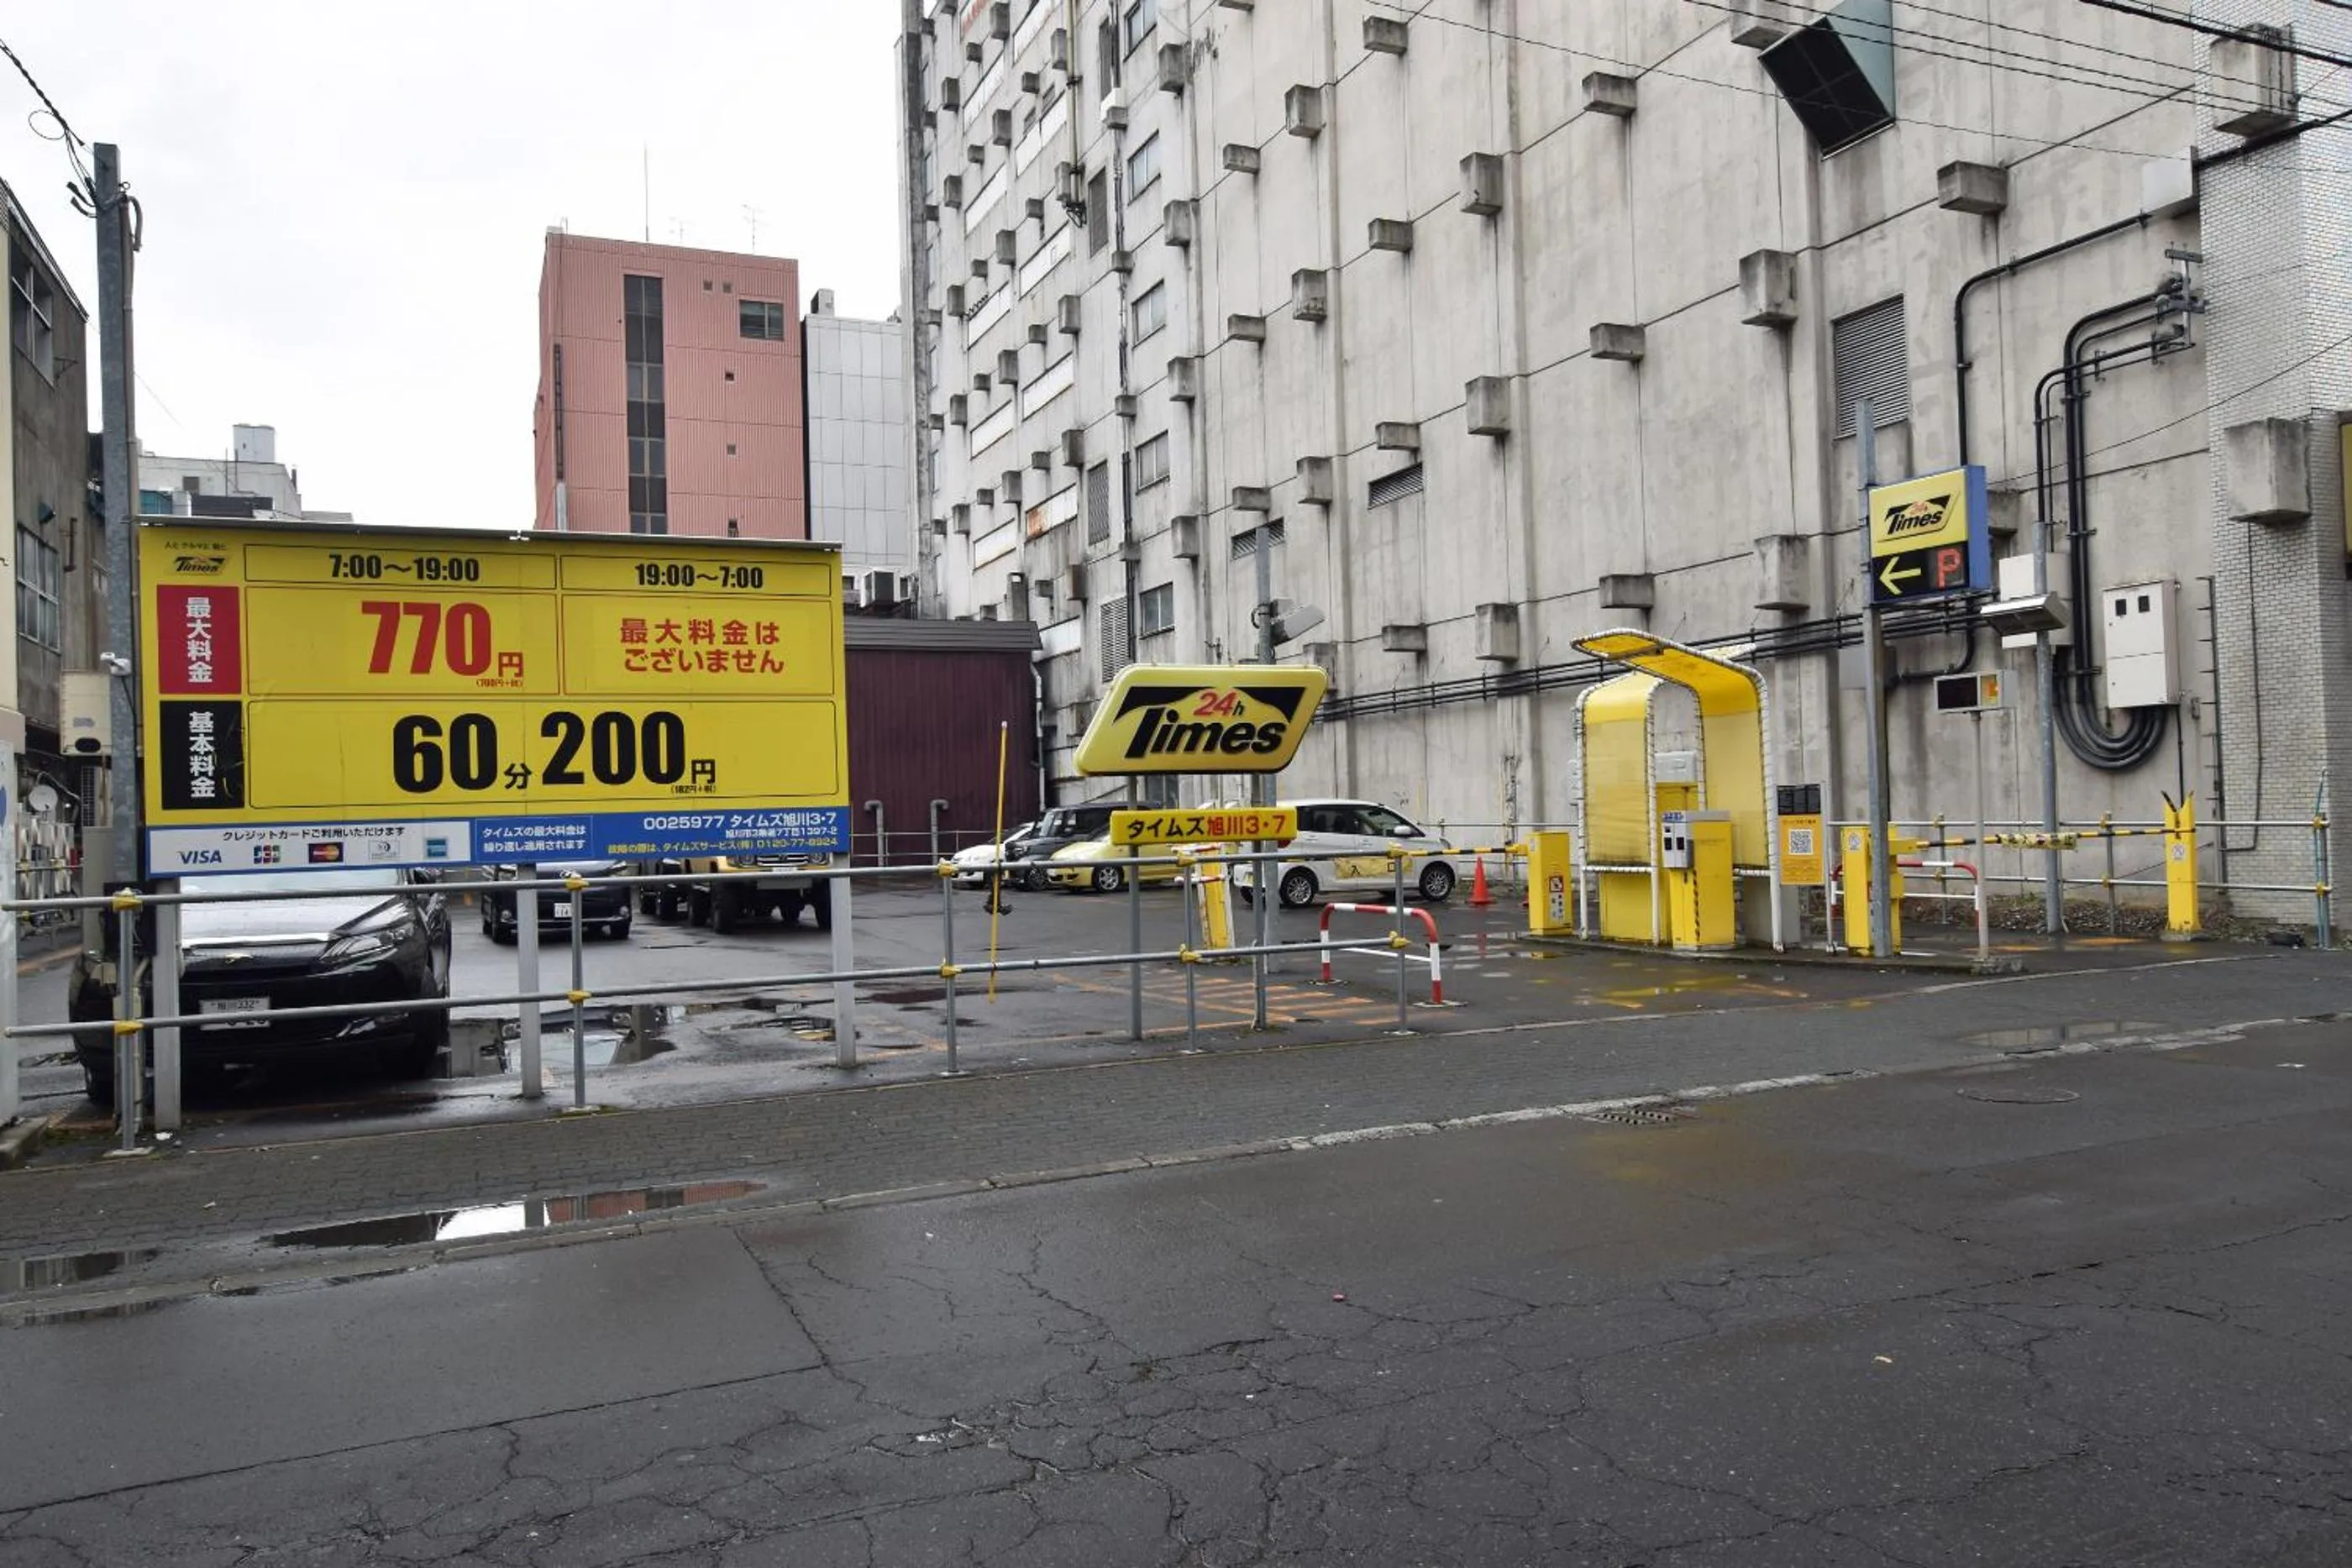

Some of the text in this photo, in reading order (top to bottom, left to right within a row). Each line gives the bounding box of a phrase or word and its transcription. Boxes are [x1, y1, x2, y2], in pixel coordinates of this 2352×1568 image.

[1886, 509, 1943, 535] Times
[1937, 548, 1961, 590] P
[186, 597, 213, 684] 最大料金
[620, 618, 780, 645] 最大料金は
[624, 648, 785, 674] ございません
[1119, 704, 1289, 759] Times
[189, 711, 215, 799] 基本料金
[223, 826, 406, 841] クレジットカードご利用いただけます
[482, 825, 586, 838] タイムズの最大料金は
[643, 815, 725, 831] 0025977
[176, 849, 223, 865] VISA
